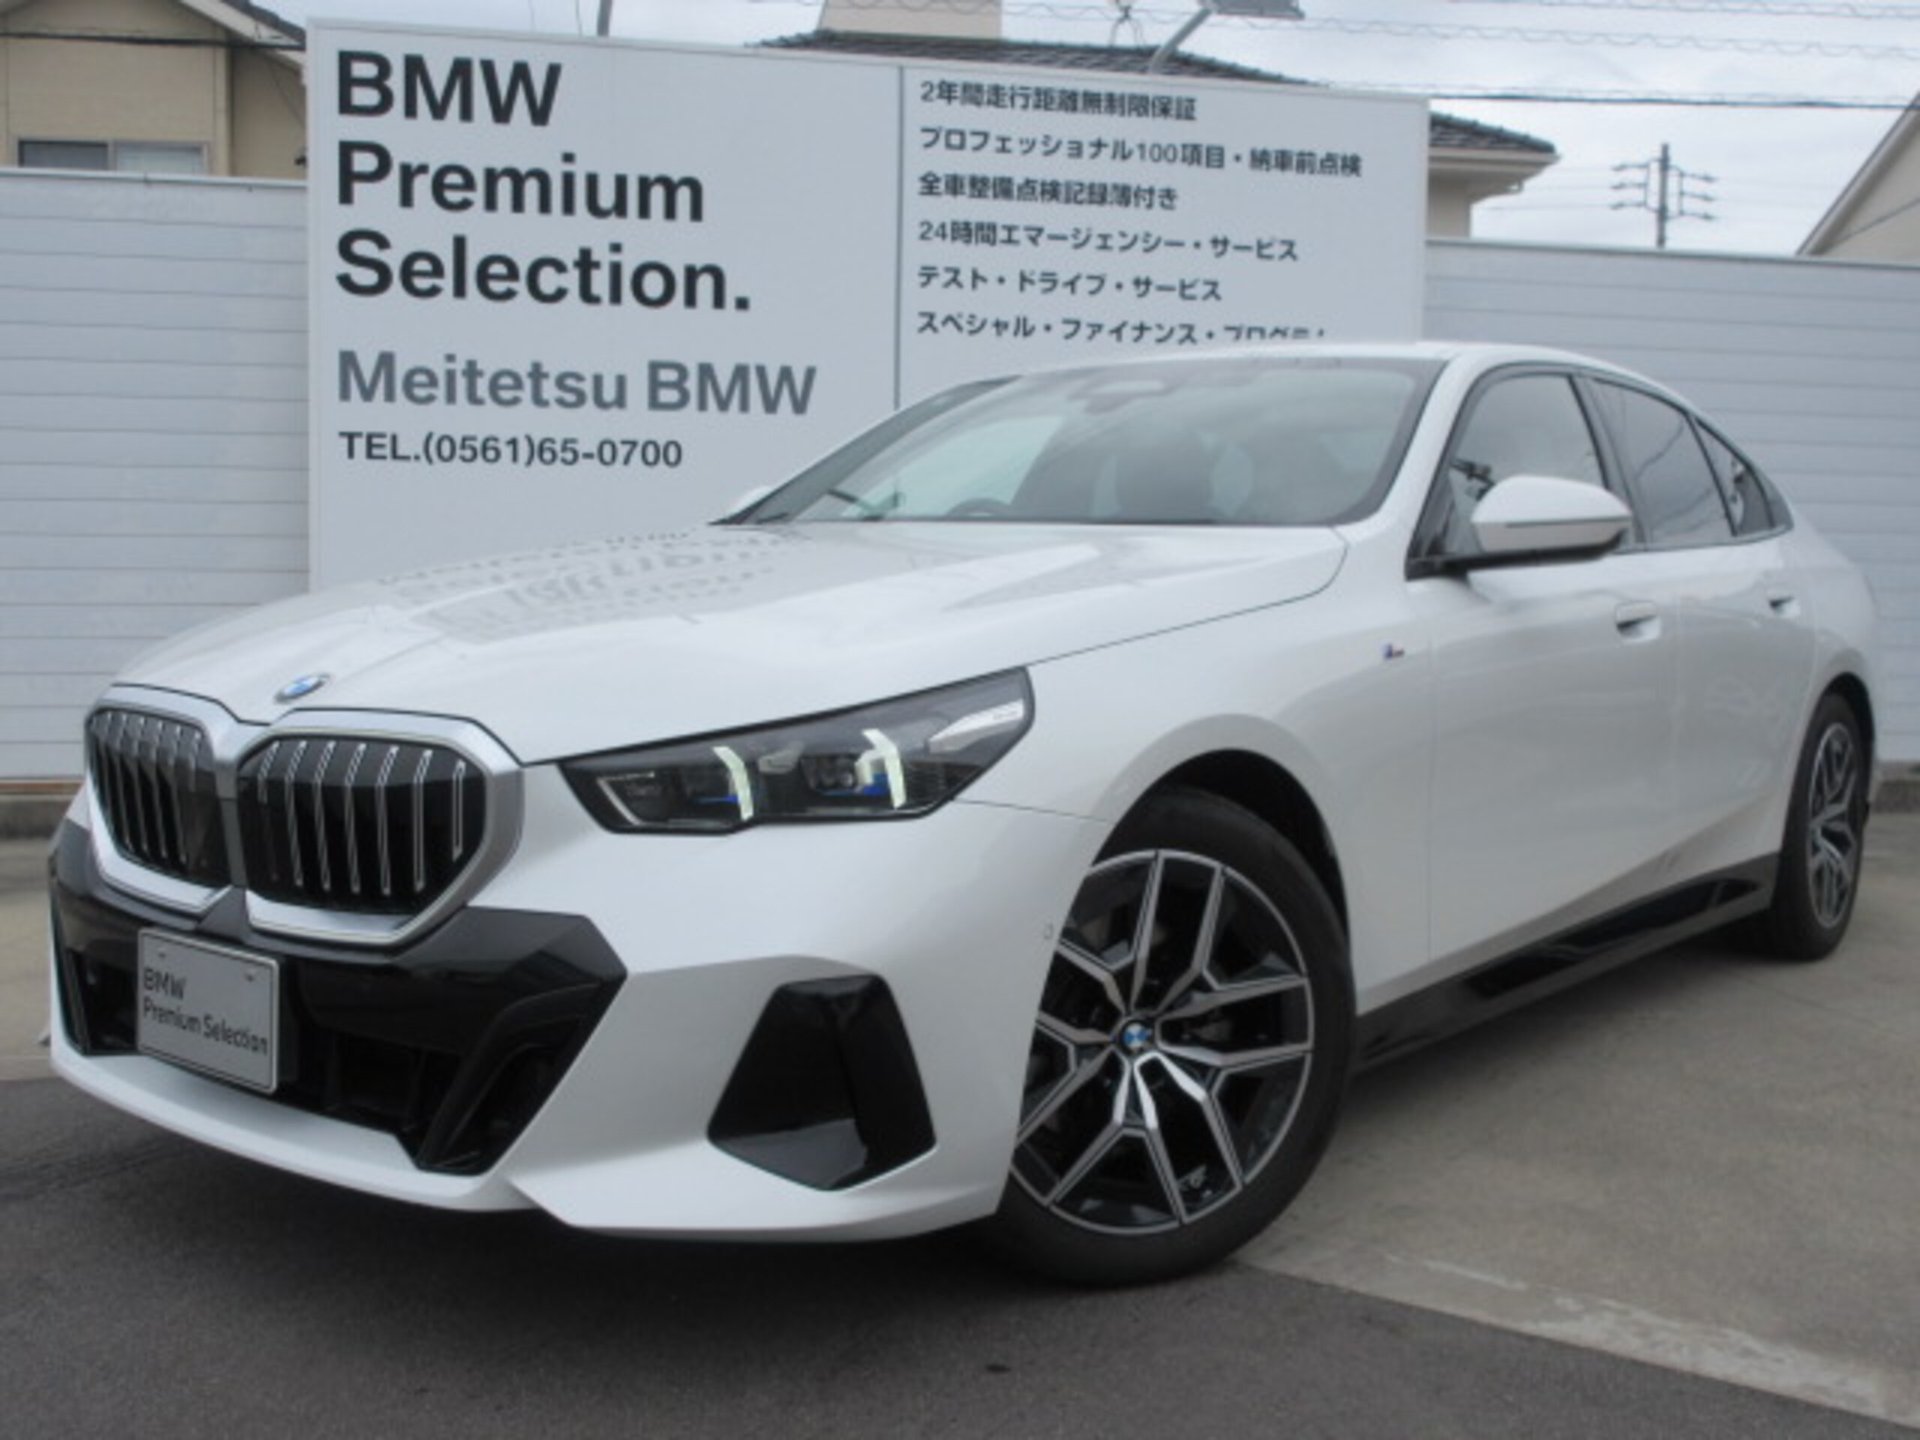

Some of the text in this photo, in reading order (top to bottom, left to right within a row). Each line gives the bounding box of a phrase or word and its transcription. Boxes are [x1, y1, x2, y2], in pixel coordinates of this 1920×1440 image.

[337, 50, 562, 126] BMW
[920, 81, 1197, 120] 2年間走行距離無制限保証
[337, 141, 704, 222] Premium
[918, 172, 1178, 210] 全車整備点検記録簿付き
[918, 221, 1299, 261] 24時間エマージェンシー・サービス
[336, 229, 750, 311] Selection.
[917, 266, 1222, 301] テスト・ドライブ・サービス
[338, 350, 817, 415] Meitetsu BMW
[339, 431, 683, 467] TEL.(0561)65-0700
[144, 967, 186, 1000] BMW
[144, 995, 268, 1056] Premium Selection
